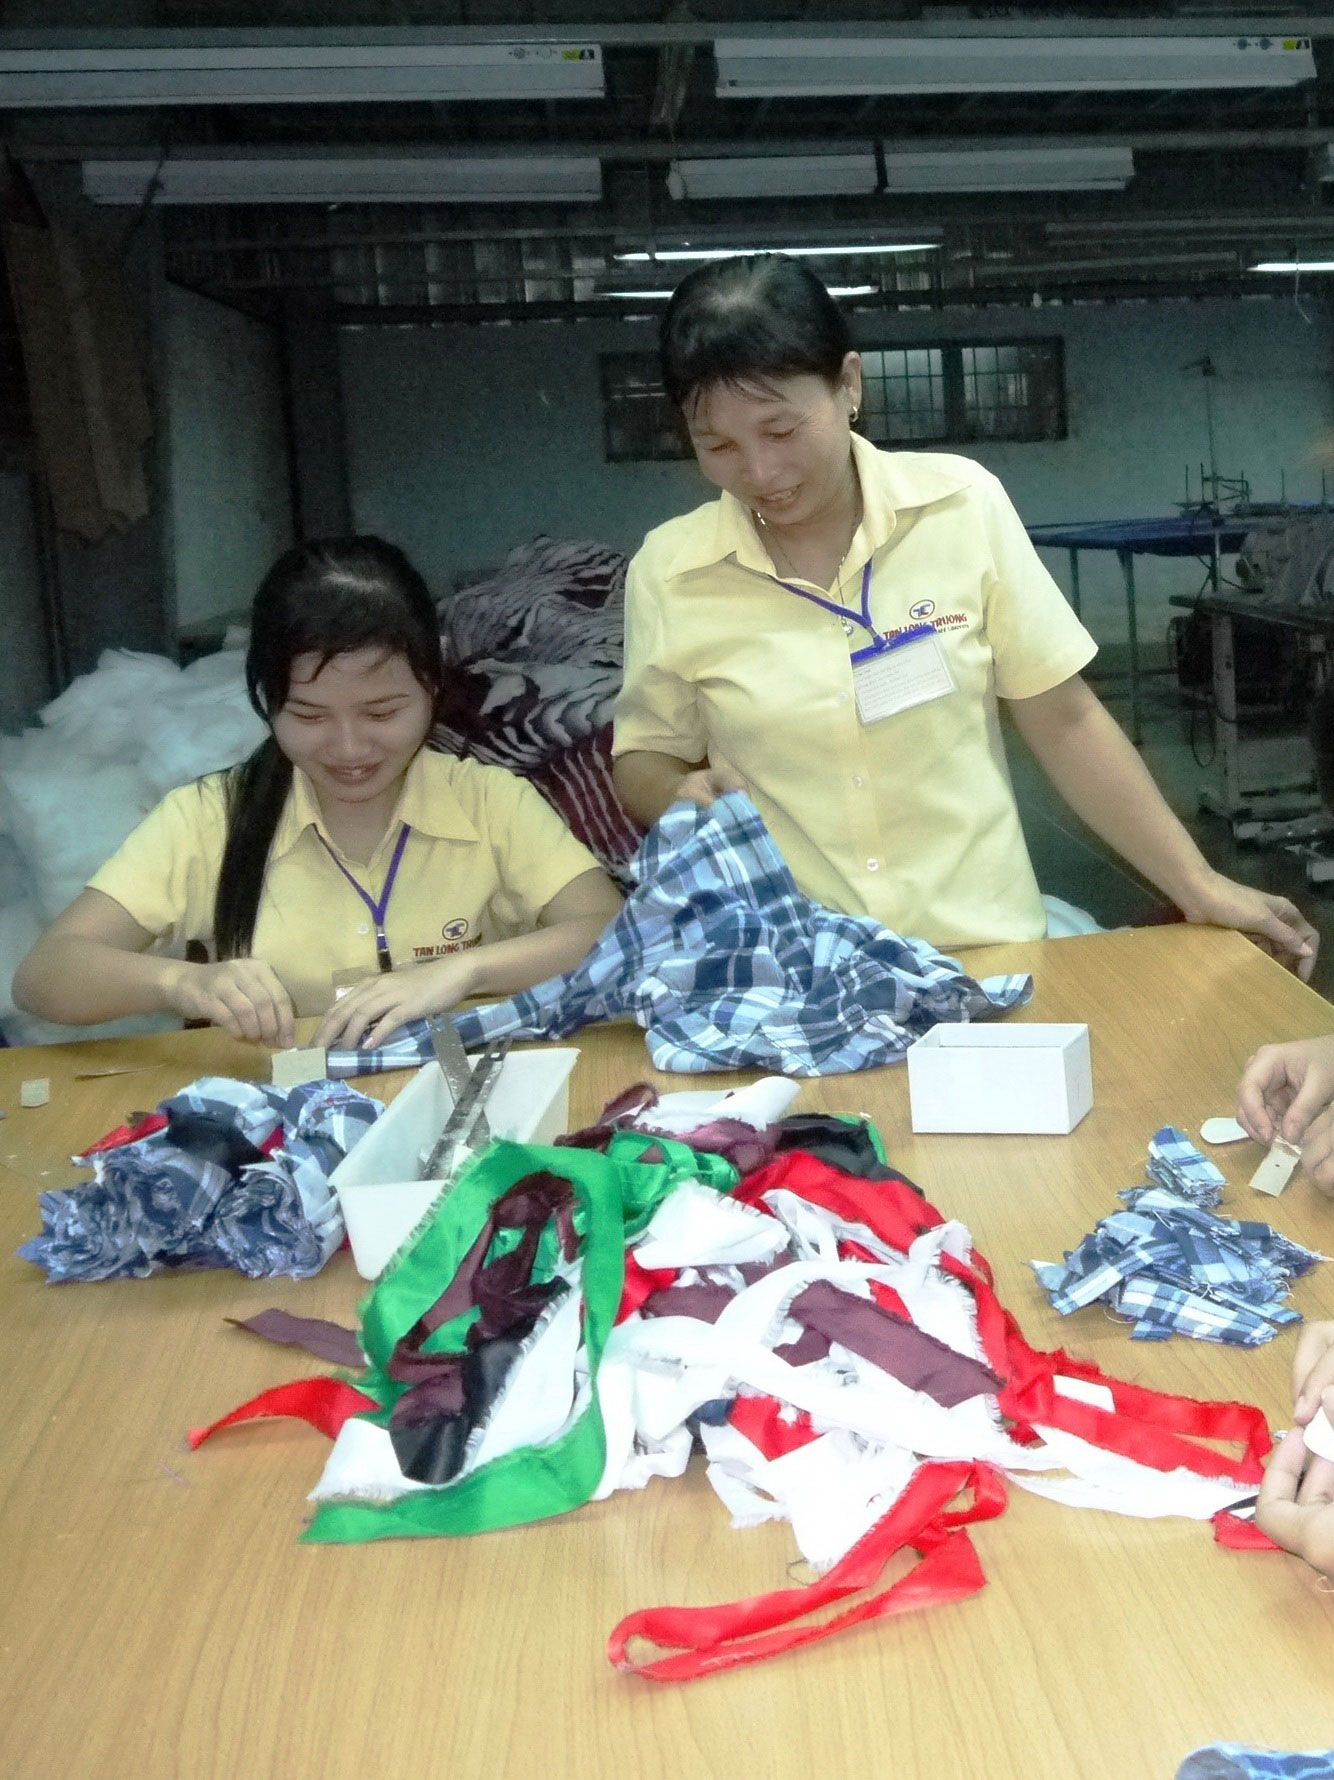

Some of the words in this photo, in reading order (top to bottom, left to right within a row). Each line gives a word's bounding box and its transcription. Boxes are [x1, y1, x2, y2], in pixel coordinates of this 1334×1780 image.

[930, 613, 967, 628] TRUONG
[412, 946, 434, 957] TAN
[436, 943, 459, 955] LONG
